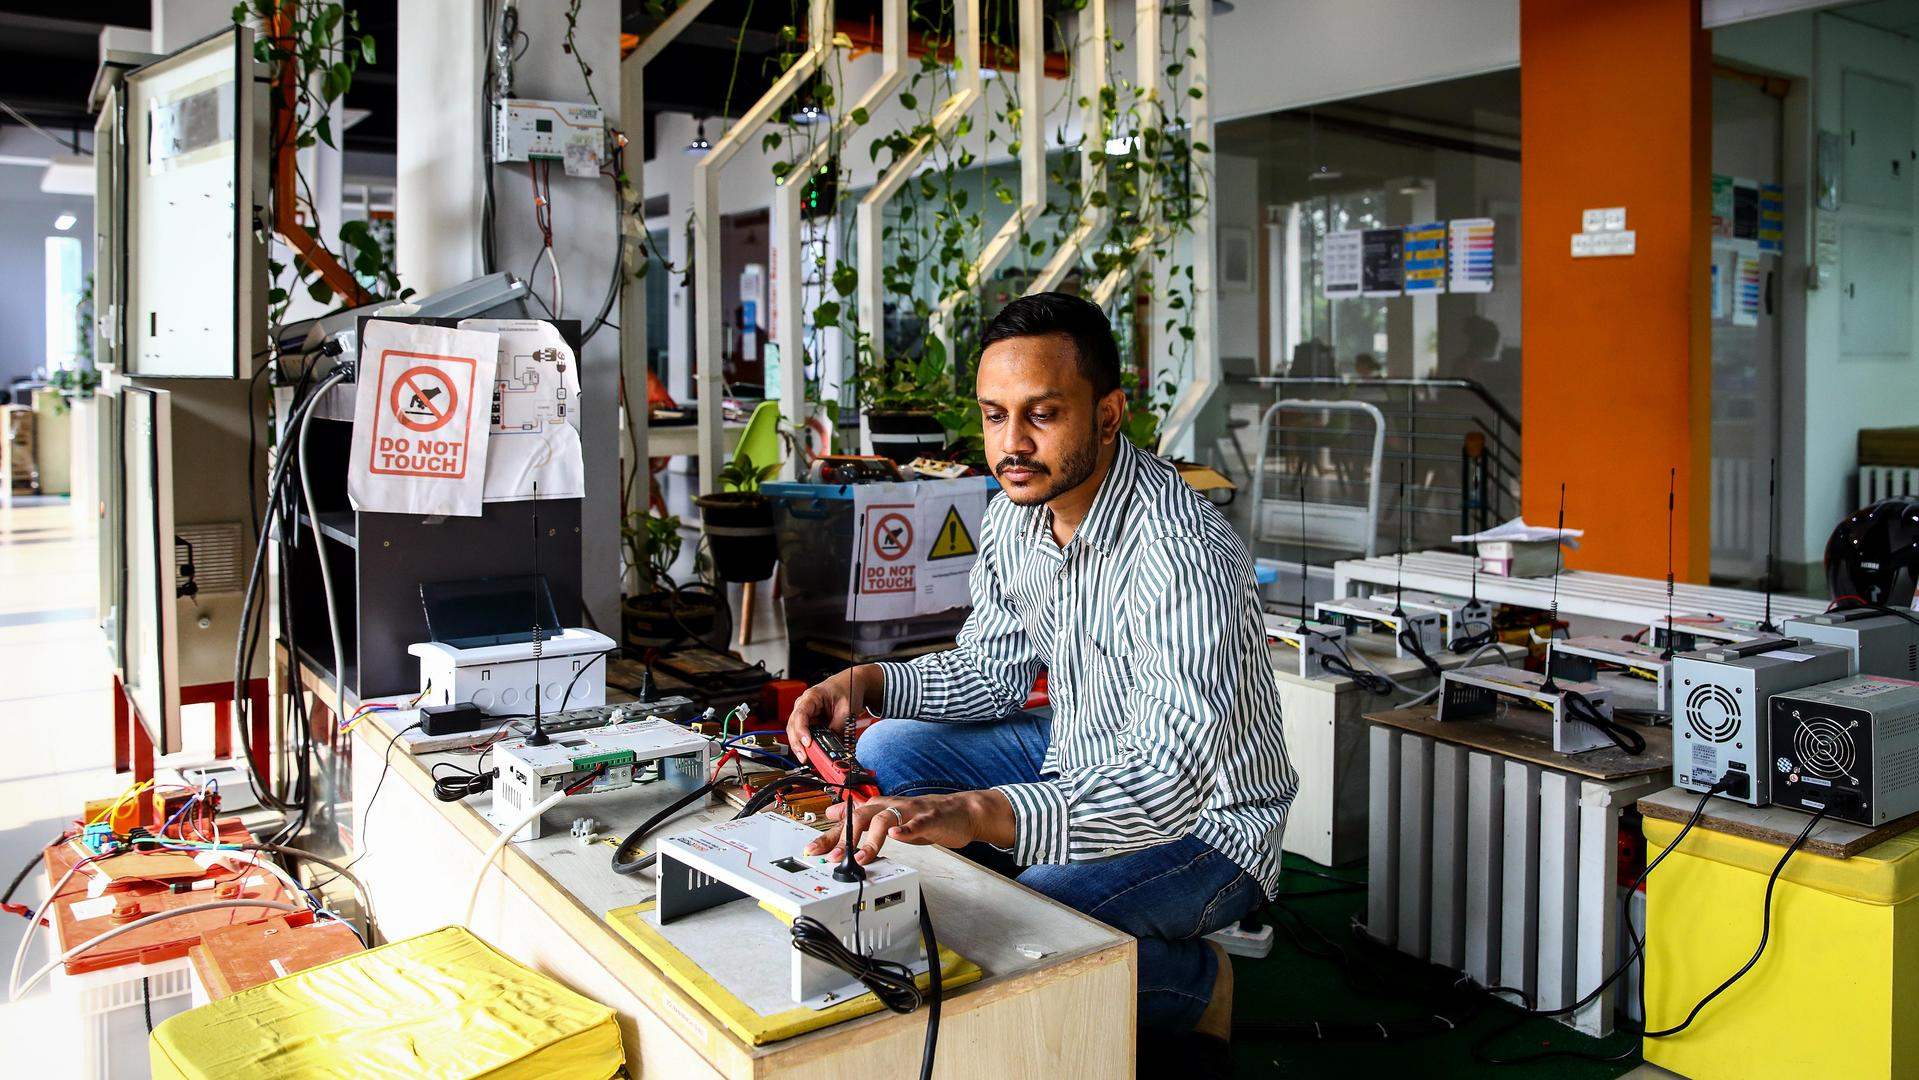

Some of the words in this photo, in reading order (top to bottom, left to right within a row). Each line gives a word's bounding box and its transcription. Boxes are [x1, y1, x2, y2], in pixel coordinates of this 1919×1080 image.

[380, 437, 410, 453] DO
[418, 440, 462, 456] NOT
[382, 454, 456, 471] TOUCH
[867, 566, 885, 577] DO
[889, 565, 916, 576] NOT
[868, 577, 913, 589] TOUCH
